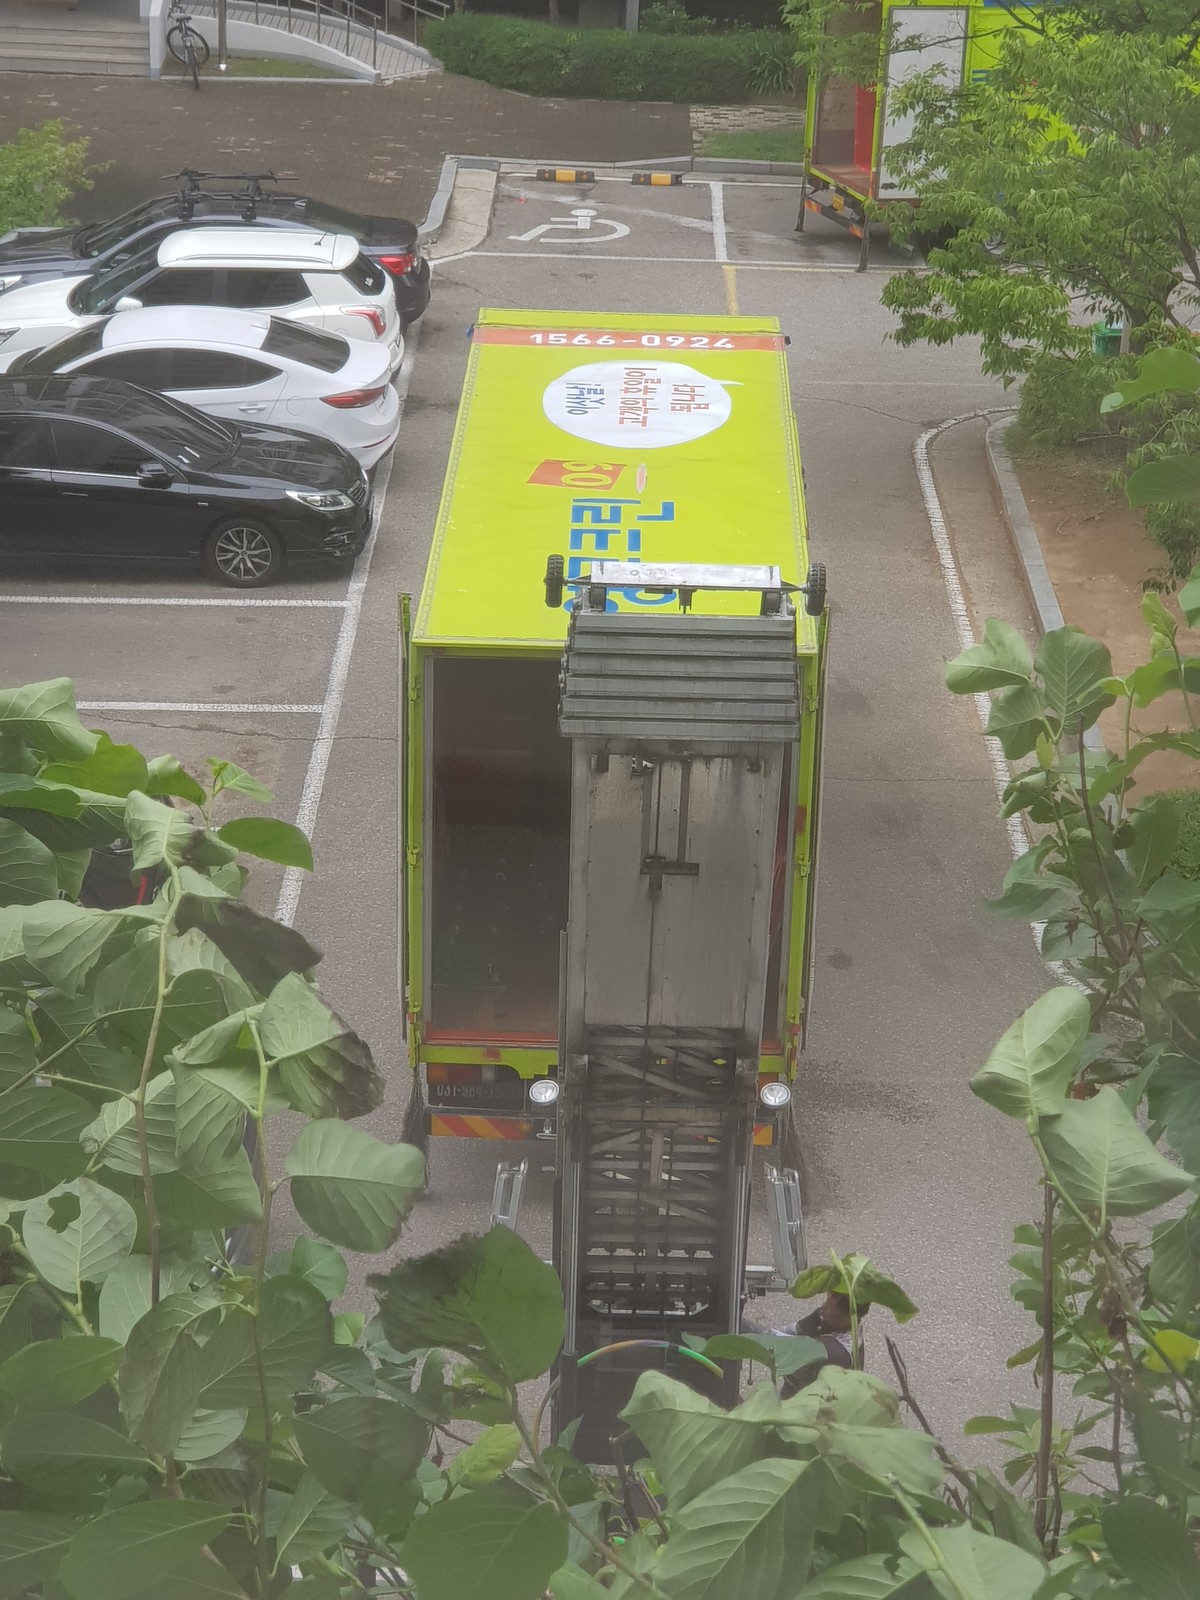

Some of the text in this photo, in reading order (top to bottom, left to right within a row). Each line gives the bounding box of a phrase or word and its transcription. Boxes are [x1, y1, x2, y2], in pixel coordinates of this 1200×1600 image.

[530, 333, 734, 348] 1566-0924
[567, 382, 605, 415] 이삿날!
[619, 368, 661, 427] 고객의 휴일이
[671, 384, 709, 412] 됩니다
